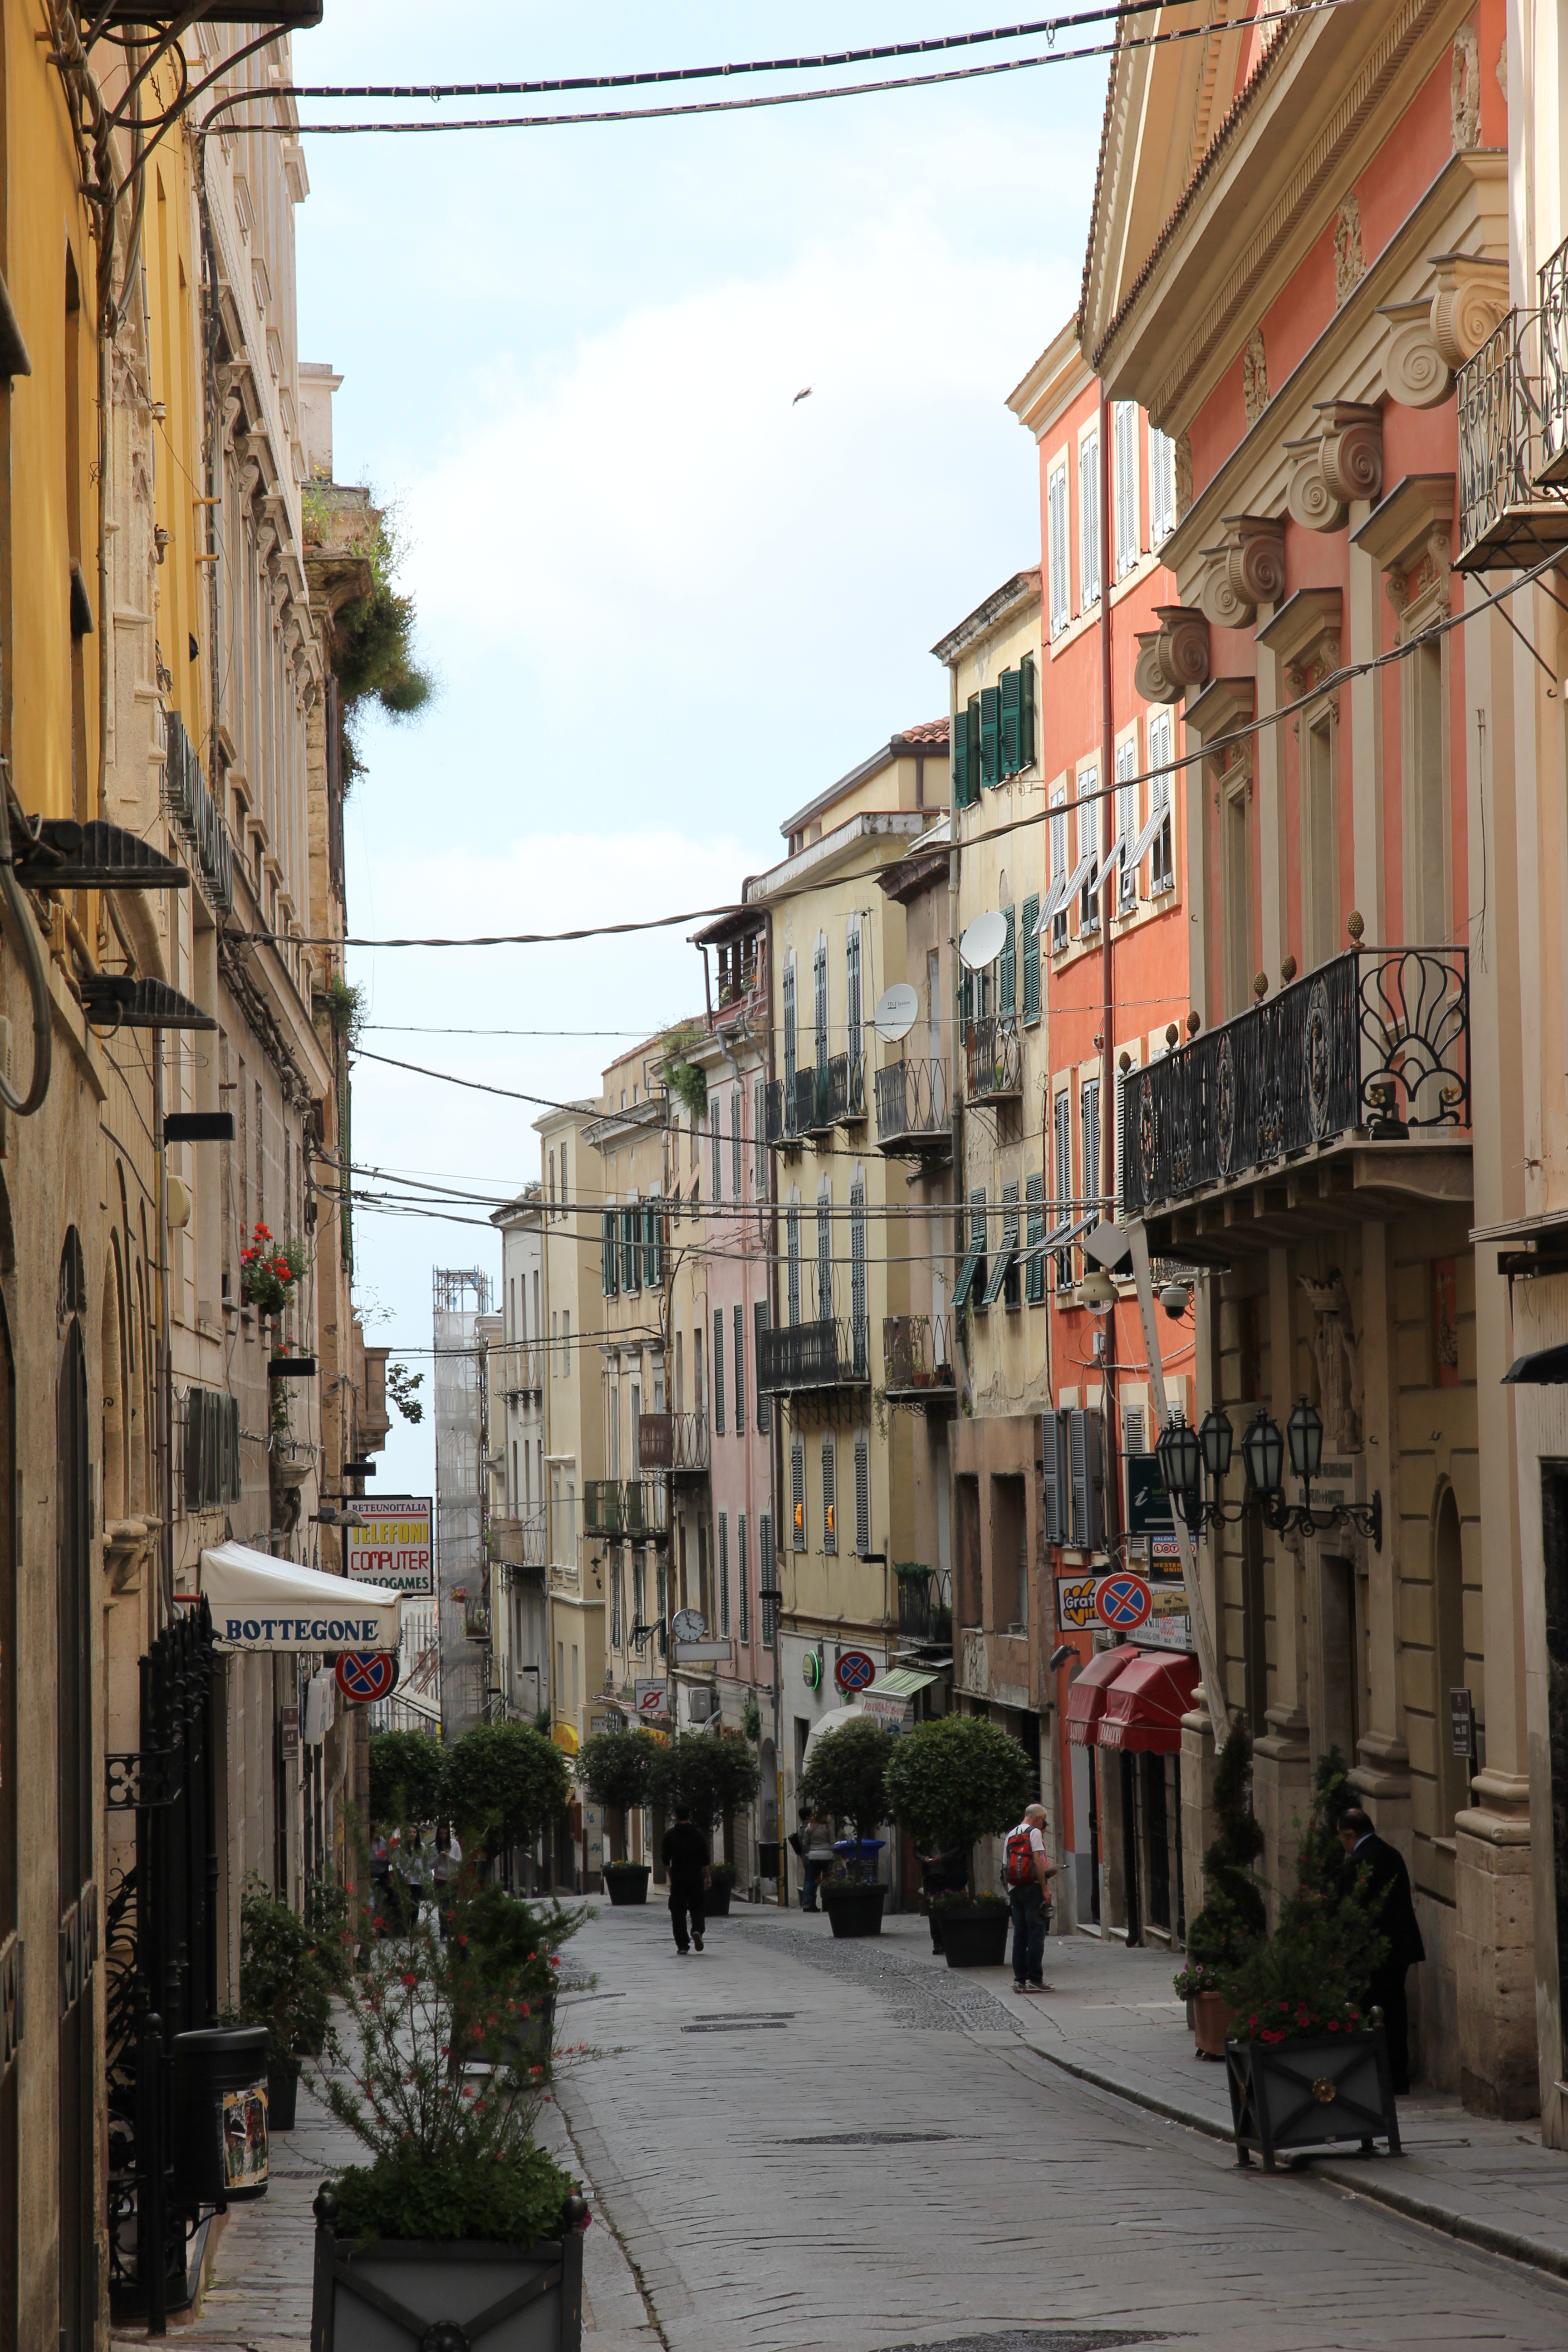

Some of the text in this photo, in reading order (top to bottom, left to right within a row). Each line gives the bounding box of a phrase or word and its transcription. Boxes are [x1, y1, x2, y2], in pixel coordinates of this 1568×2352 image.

[352, 1504, 427, 1512] RETEUNOITALIA
[353, 1523, 428, 1544] TELEFONI
[351, 1550, 429, 1571] COMPUTER
[1066, 1594, 1095, 1608] Grat
[1069, 1607, 1098, 1626] Vin
[225, 1619, 380, 1641] BOTTEGONE
